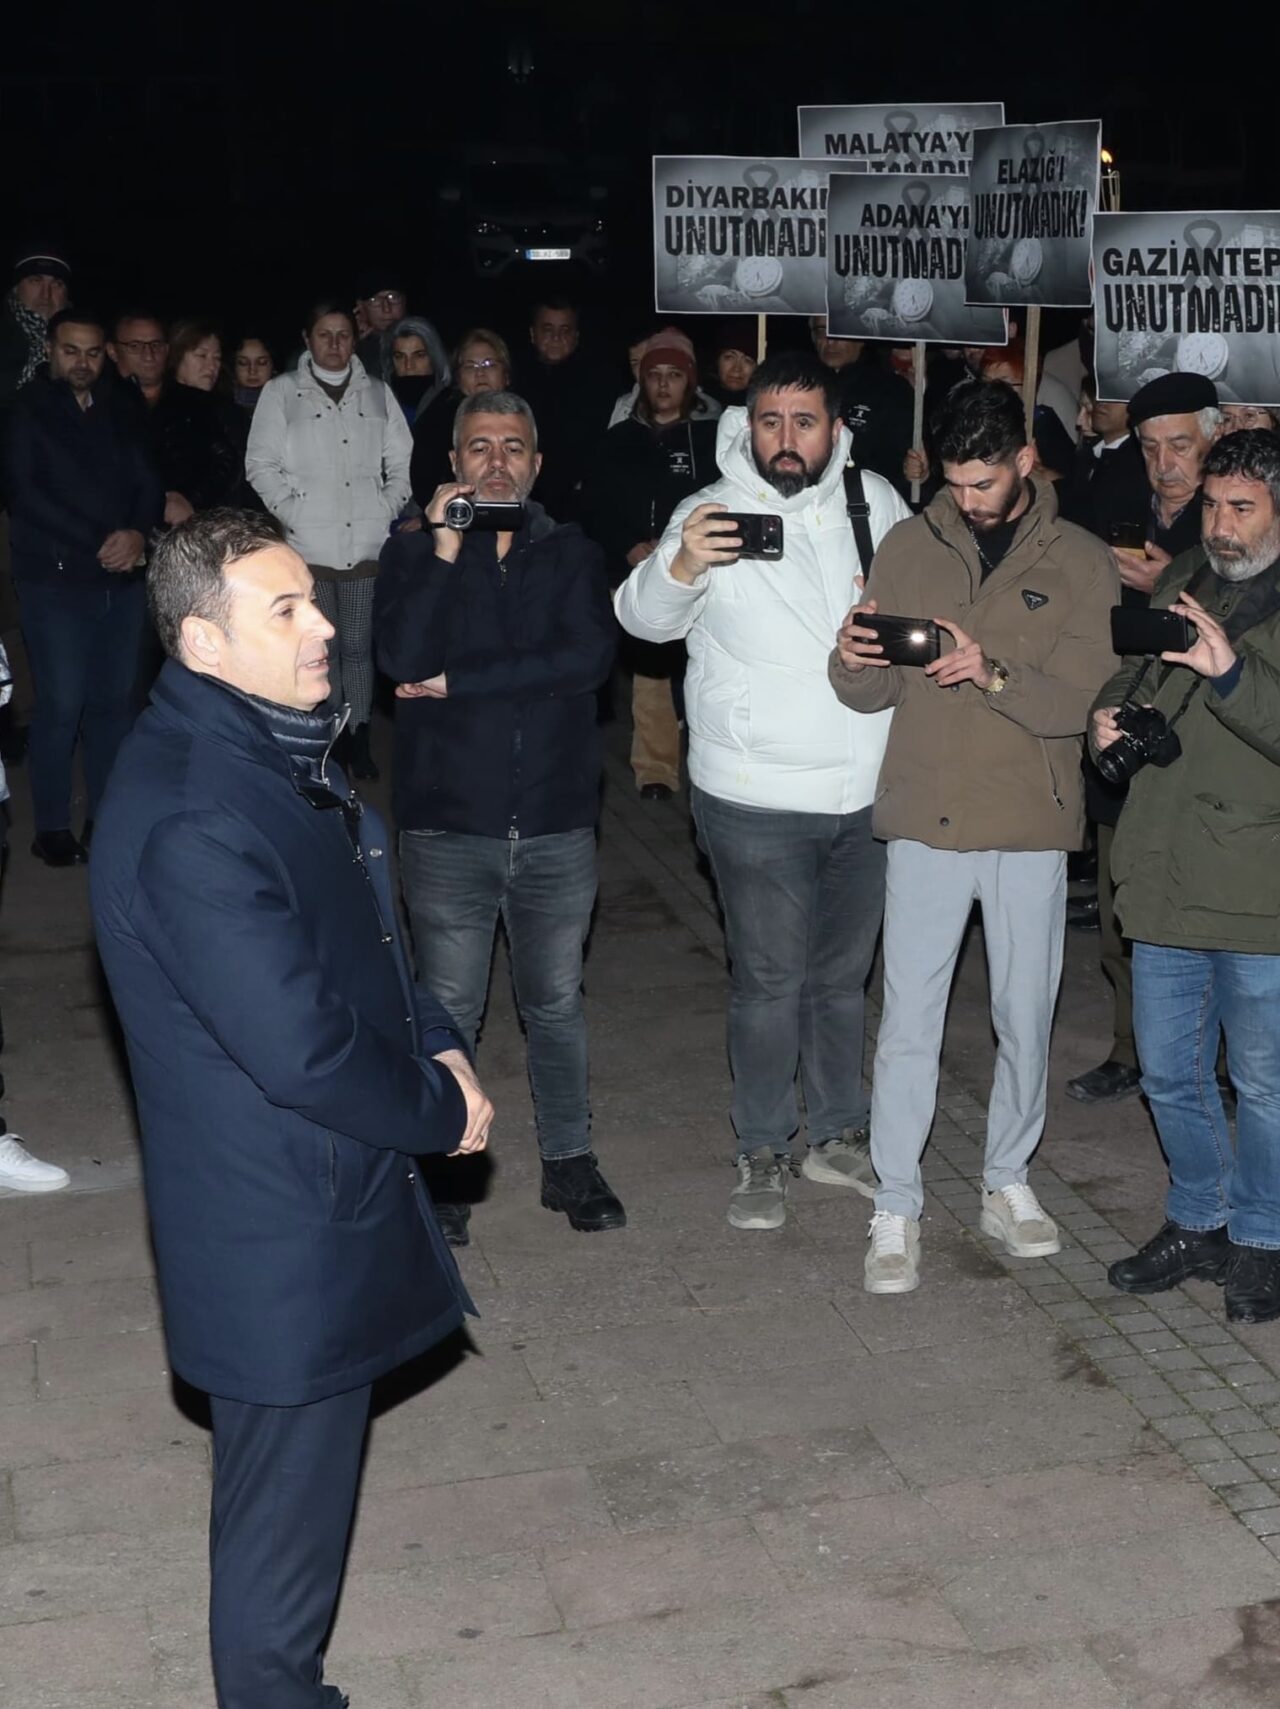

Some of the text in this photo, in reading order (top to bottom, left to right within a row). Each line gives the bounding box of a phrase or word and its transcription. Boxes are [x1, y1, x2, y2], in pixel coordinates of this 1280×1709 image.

[997, 147, 1065, 185] ELAZIĞ'I
[860, 203, 970, 230] ADANA'YI
[974, 189, 1088, 240] UNUTMADIK!
